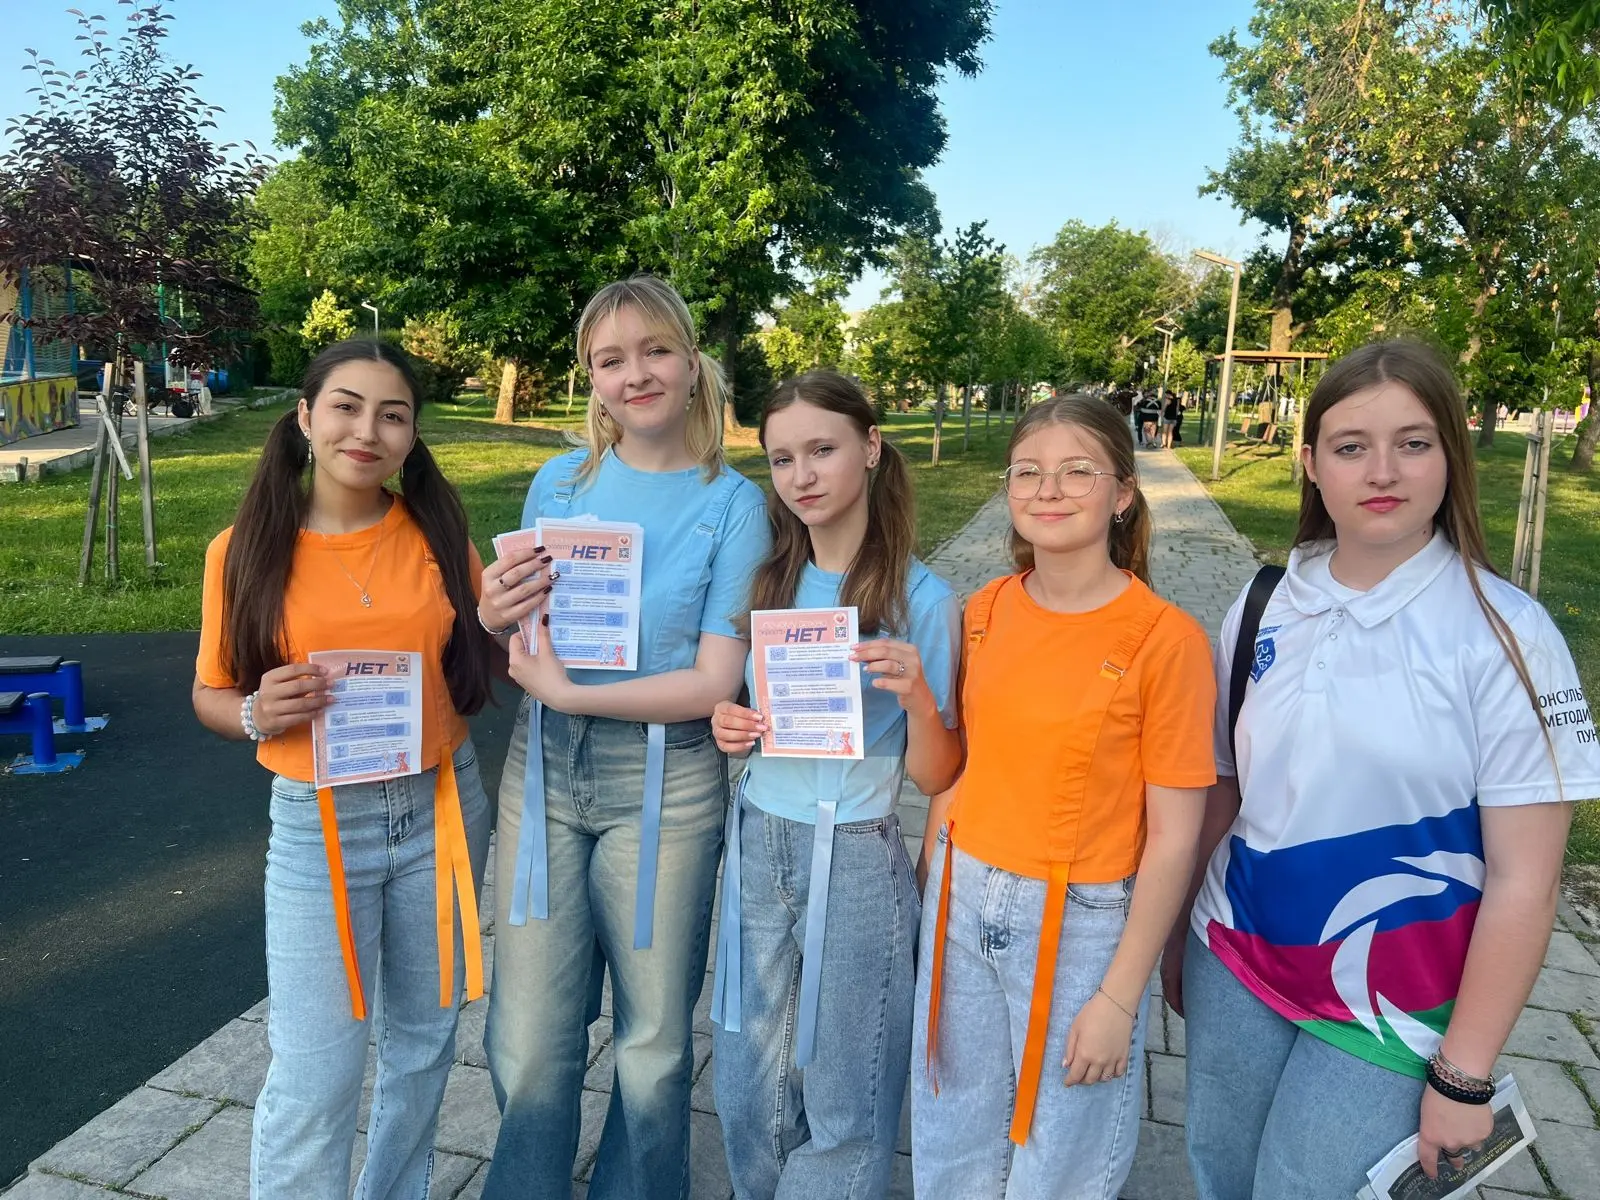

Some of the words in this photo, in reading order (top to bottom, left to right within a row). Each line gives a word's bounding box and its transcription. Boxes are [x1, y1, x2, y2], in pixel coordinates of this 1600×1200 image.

[571, 545, 611, 560] НЕТ
[785, 627, 827, 643] НЕТ
[345, 662, 389, 676] НЕТ
[1535, 687, 1583, 709] ОНСУЛЬ
